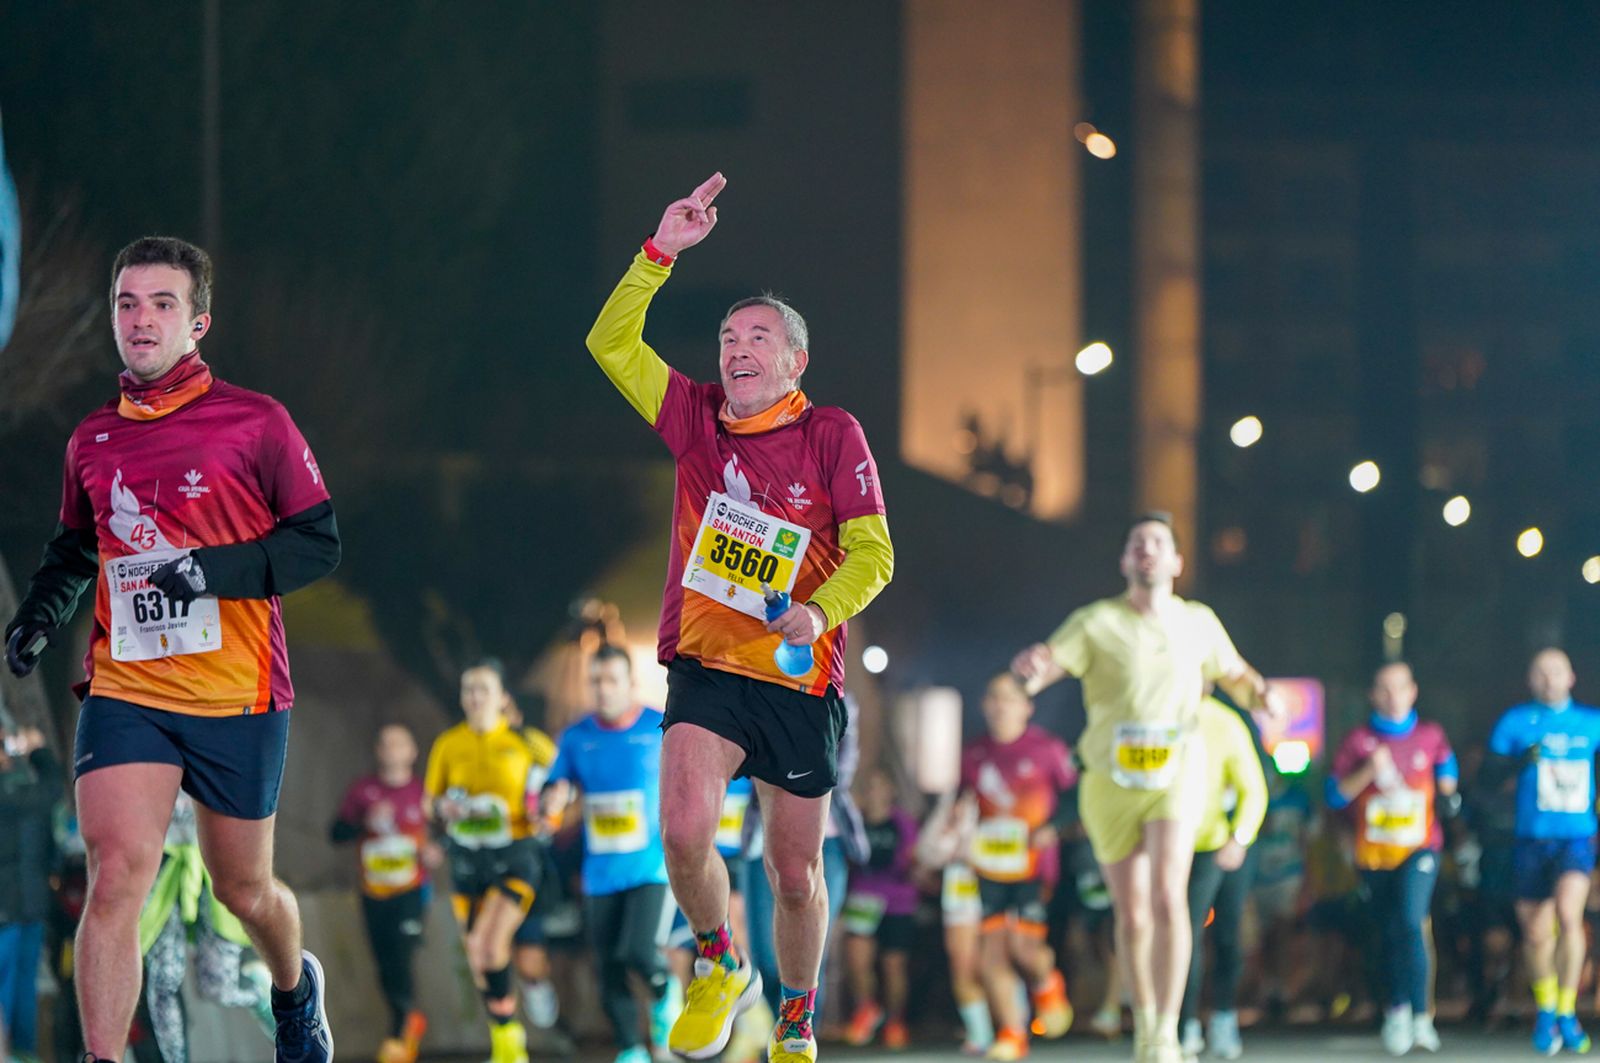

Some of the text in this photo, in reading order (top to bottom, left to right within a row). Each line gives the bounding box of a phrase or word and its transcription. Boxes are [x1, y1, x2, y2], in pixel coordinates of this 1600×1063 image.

[712, 518, 732, 535] SAN
[731, 526, 765, 548] ANTÓN
[725, 511, 756, 531] NOCHE
[756, 522, 769, 536] DE
[129, 524, 157, 550] 43
[710, 533, 779, 584] 3560
[128, 564, 155, 577] NOCHE
[727, 572, 745, 585] FELIX
[120, 580, 138, 593] SAN
[139, 621, 188, 633] Francisco Javier
